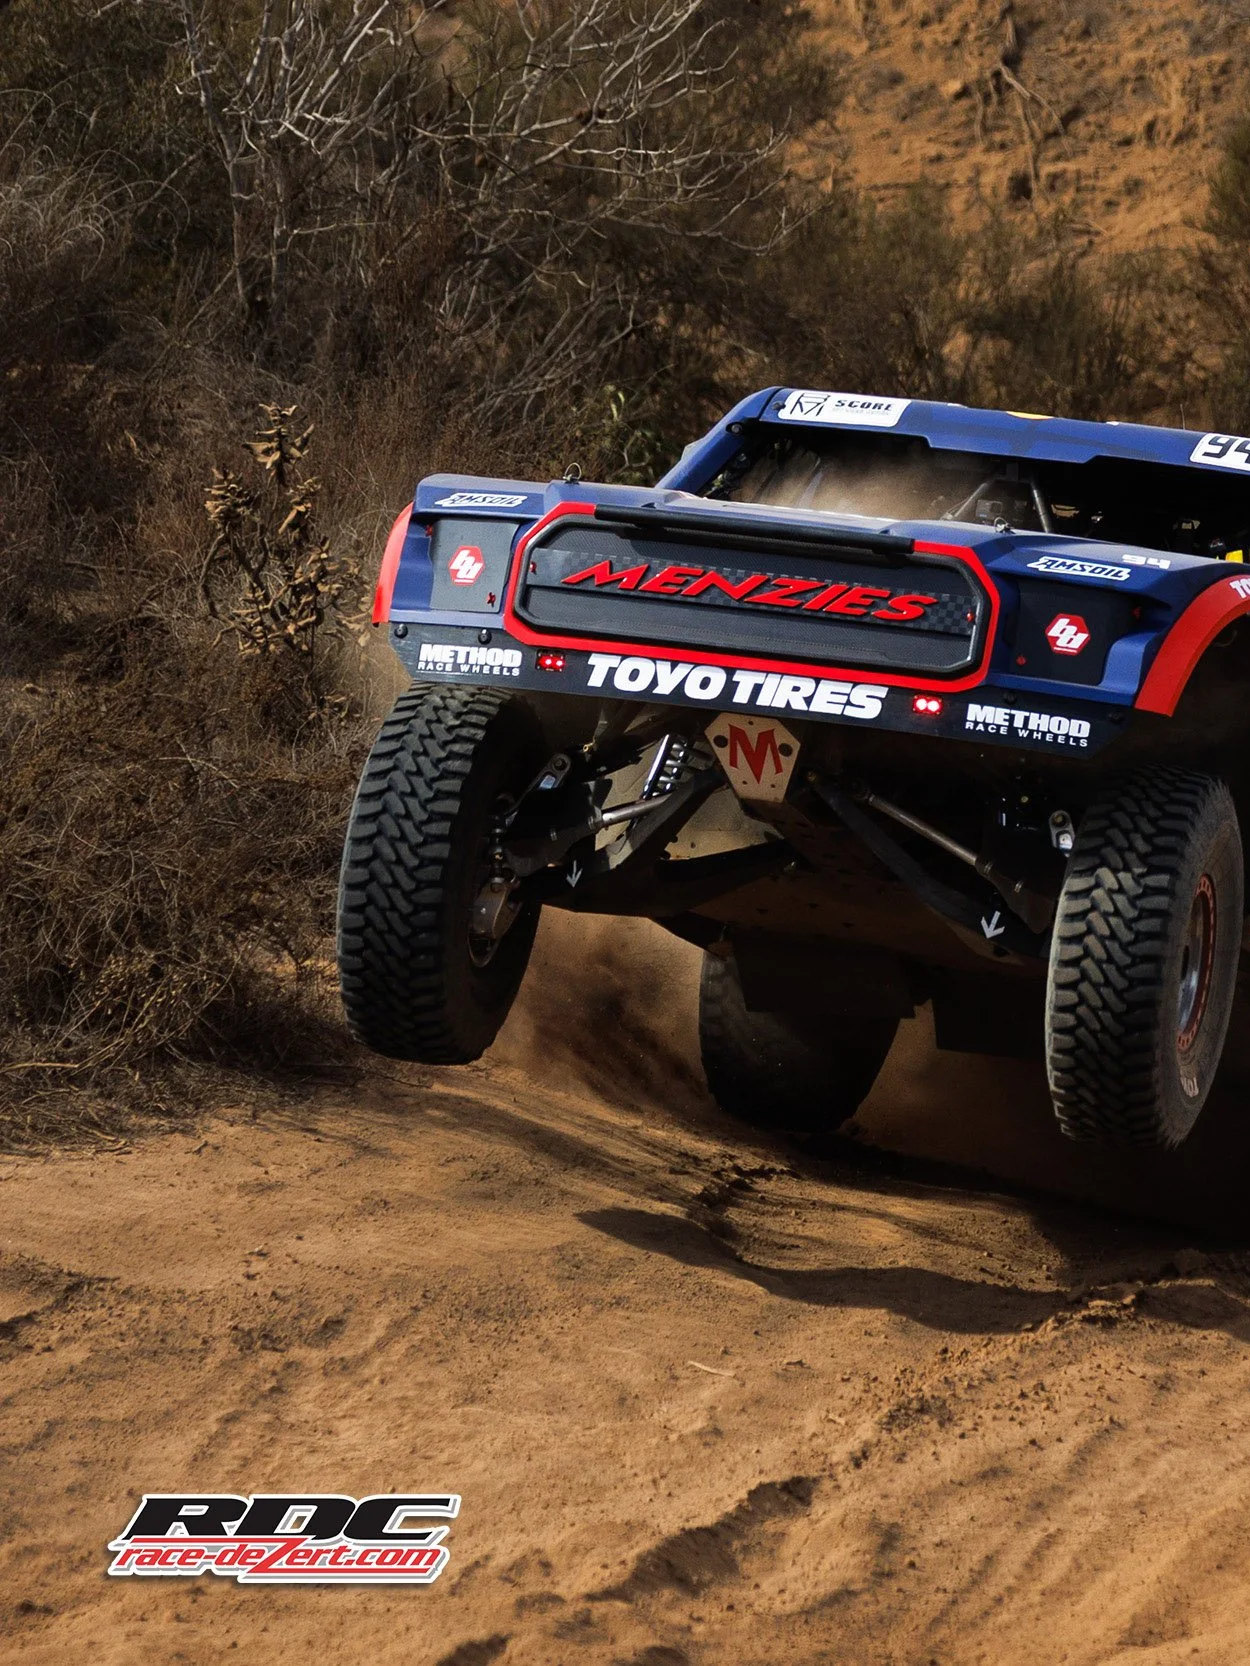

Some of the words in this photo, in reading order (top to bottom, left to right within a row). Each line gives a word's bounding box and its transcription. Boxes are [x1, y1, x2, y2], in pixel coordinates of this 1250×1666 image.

[834, 399, 896, 411] SCORE
[438, 492, 527, 507] AMSOIL
[1029, 556, 1130, 581] AMSOIL
[560, 559, 939, 621] MENZIES
[419, 643, 523, 668] METHOD
[417, 661, 453, 672] RACE
[460, 664, 520, 677] WHEELS
[586, 653, 727, 701] TOYO
[732, 669, 889, 720] TIRES
[966, 703, 1091, 738] METHOD
[965, 721, 1008, 735] RACE
[1017, 728, 1089, 747] WHEELS
